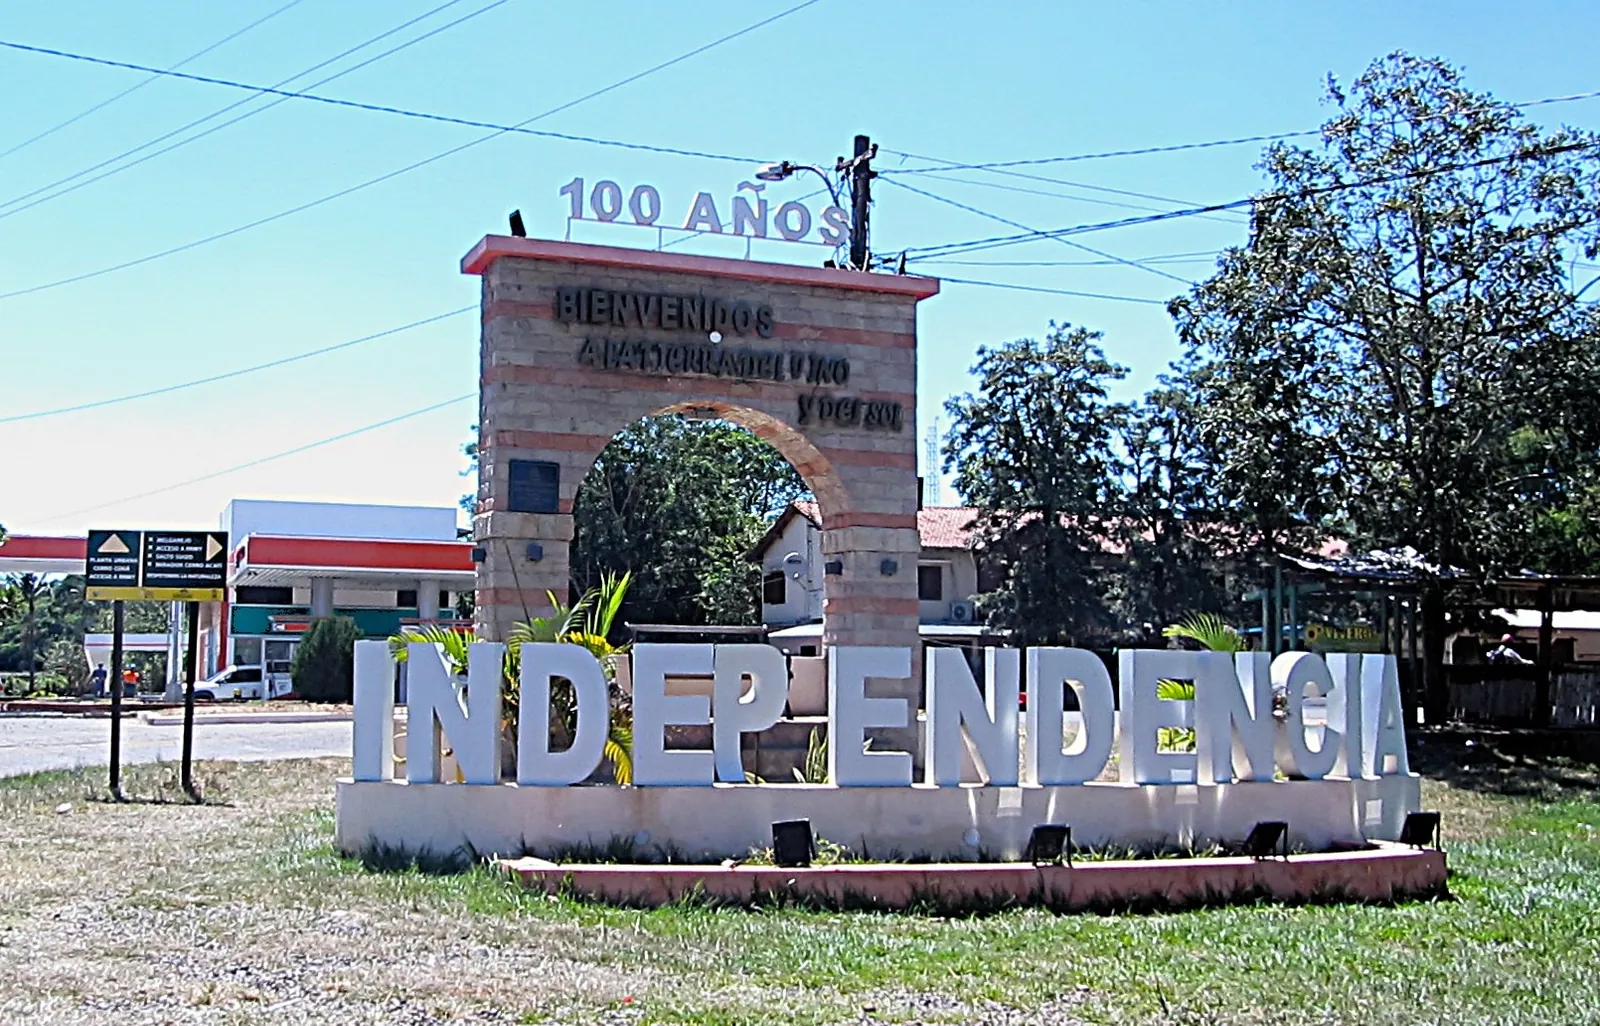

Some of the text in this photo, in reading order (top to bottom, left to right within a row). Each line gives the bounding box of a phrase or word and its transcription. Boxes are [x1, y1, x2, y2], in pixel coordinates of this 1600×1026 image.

[560, 177, 851, 247] 100 AÑOS
[557, 287, 776, 339] BIENVENIDOS
[353, 640, 1410, 787] INDEPENDENCIA
